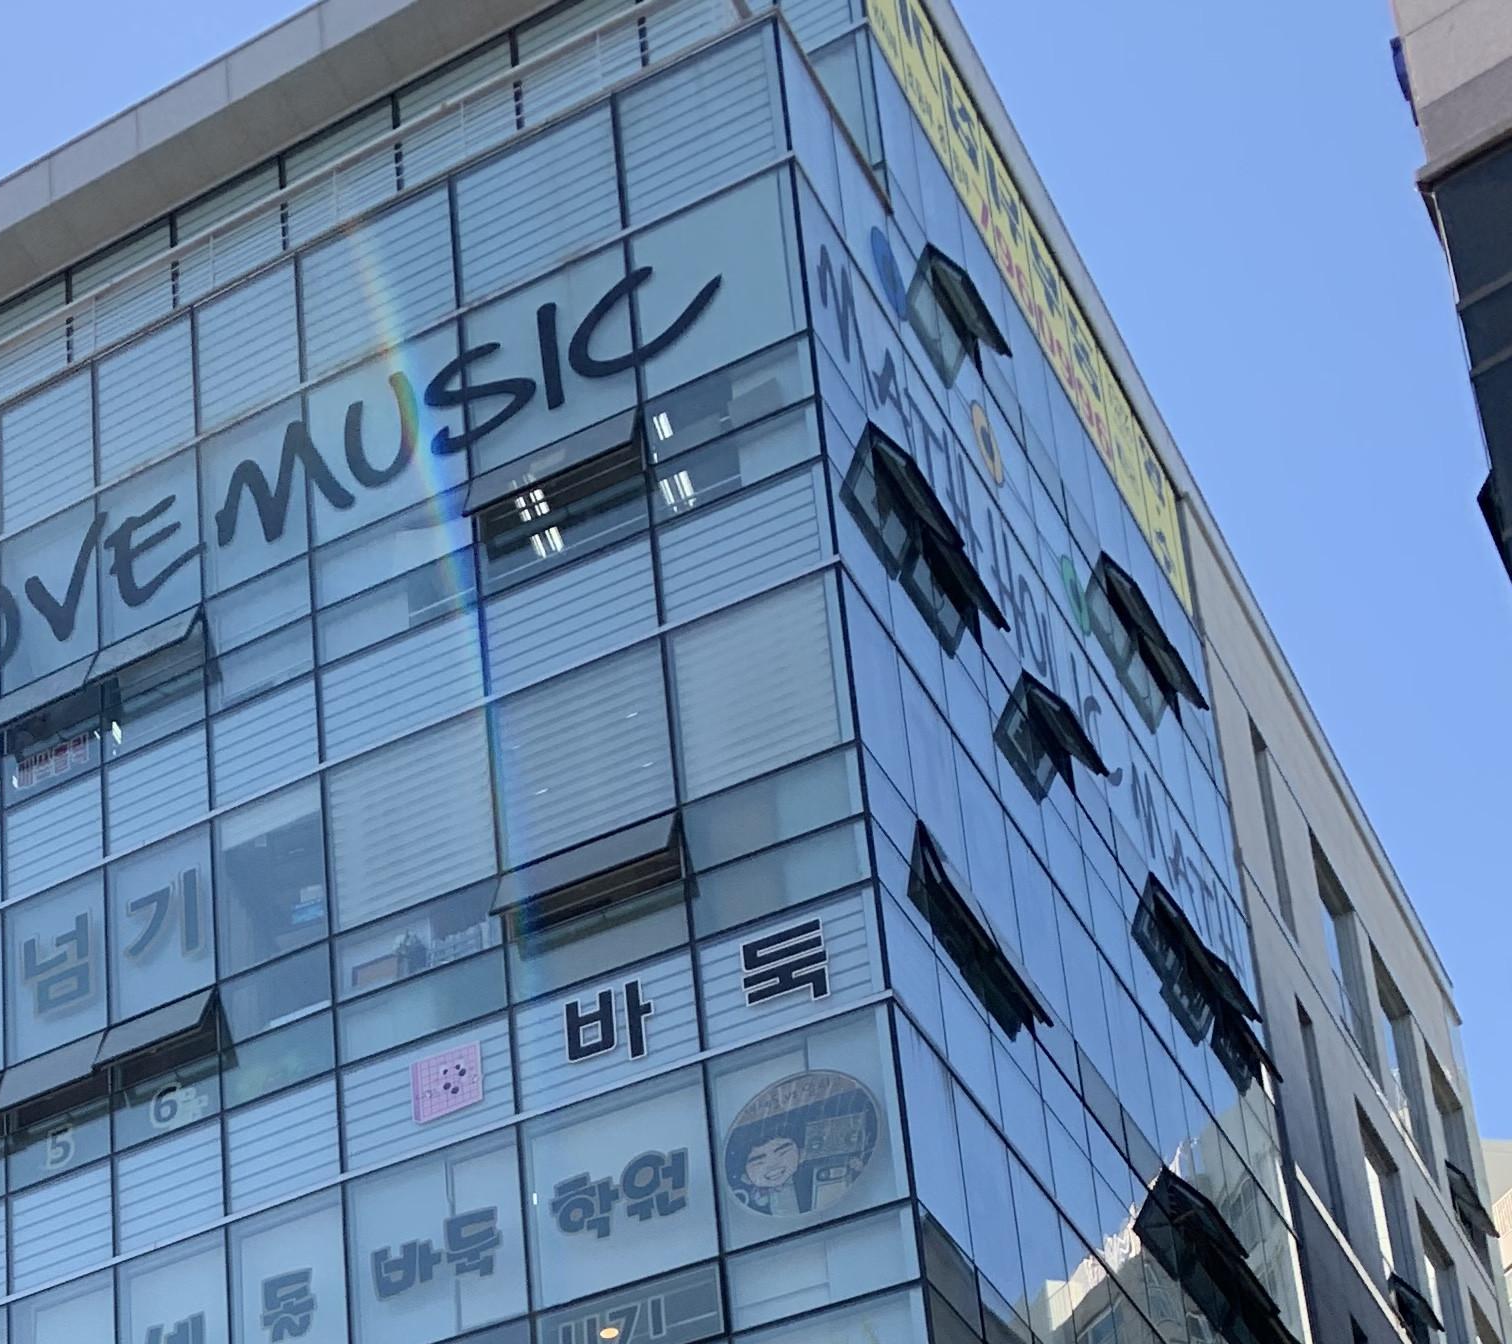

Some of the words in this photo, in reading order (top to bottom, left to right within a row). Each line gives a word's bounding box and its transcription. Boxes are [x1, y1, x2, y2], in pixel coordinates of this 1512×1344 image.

[216, 265, 723, 546] MUSIC
[564, 916, 832, 1064] 바둑
[368, 1204, 502, 1302] 바둑
[550, 1144, 691, 1242] 학원
